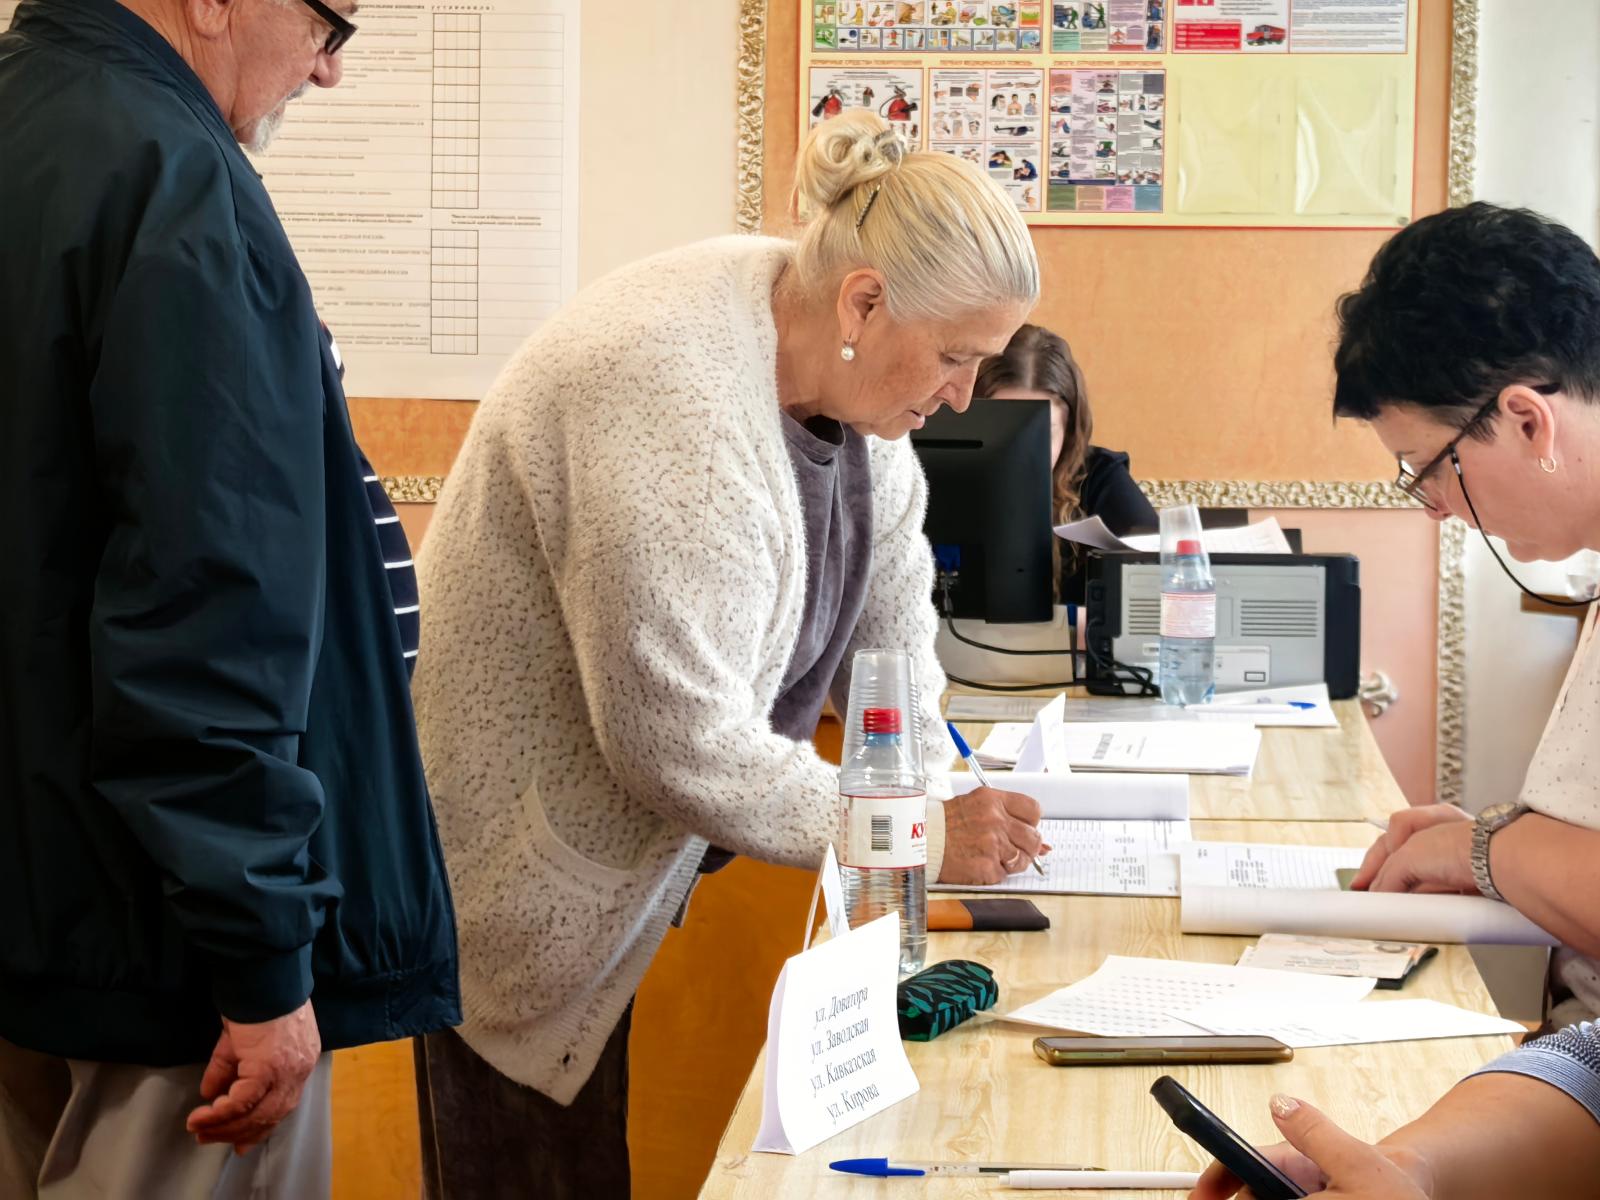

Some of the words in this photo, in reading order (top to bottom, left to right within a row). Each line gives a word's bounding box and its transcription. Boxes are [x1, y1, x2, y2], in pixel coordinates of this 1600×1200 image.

[814, 1008, 826, 1030] ул.
[829, 987, 868, 1019] Доватора
[811, 1040, 824, 1064] ул.
[826, 1018, 869, 1051] Заводская
[810, 1074, 826, 1098] ул.
[826, 1048, 877, 1084] Кавказская
[827, 1102, 844, 1125] ул.
[841, 1083, 880, 1112] Кирова
